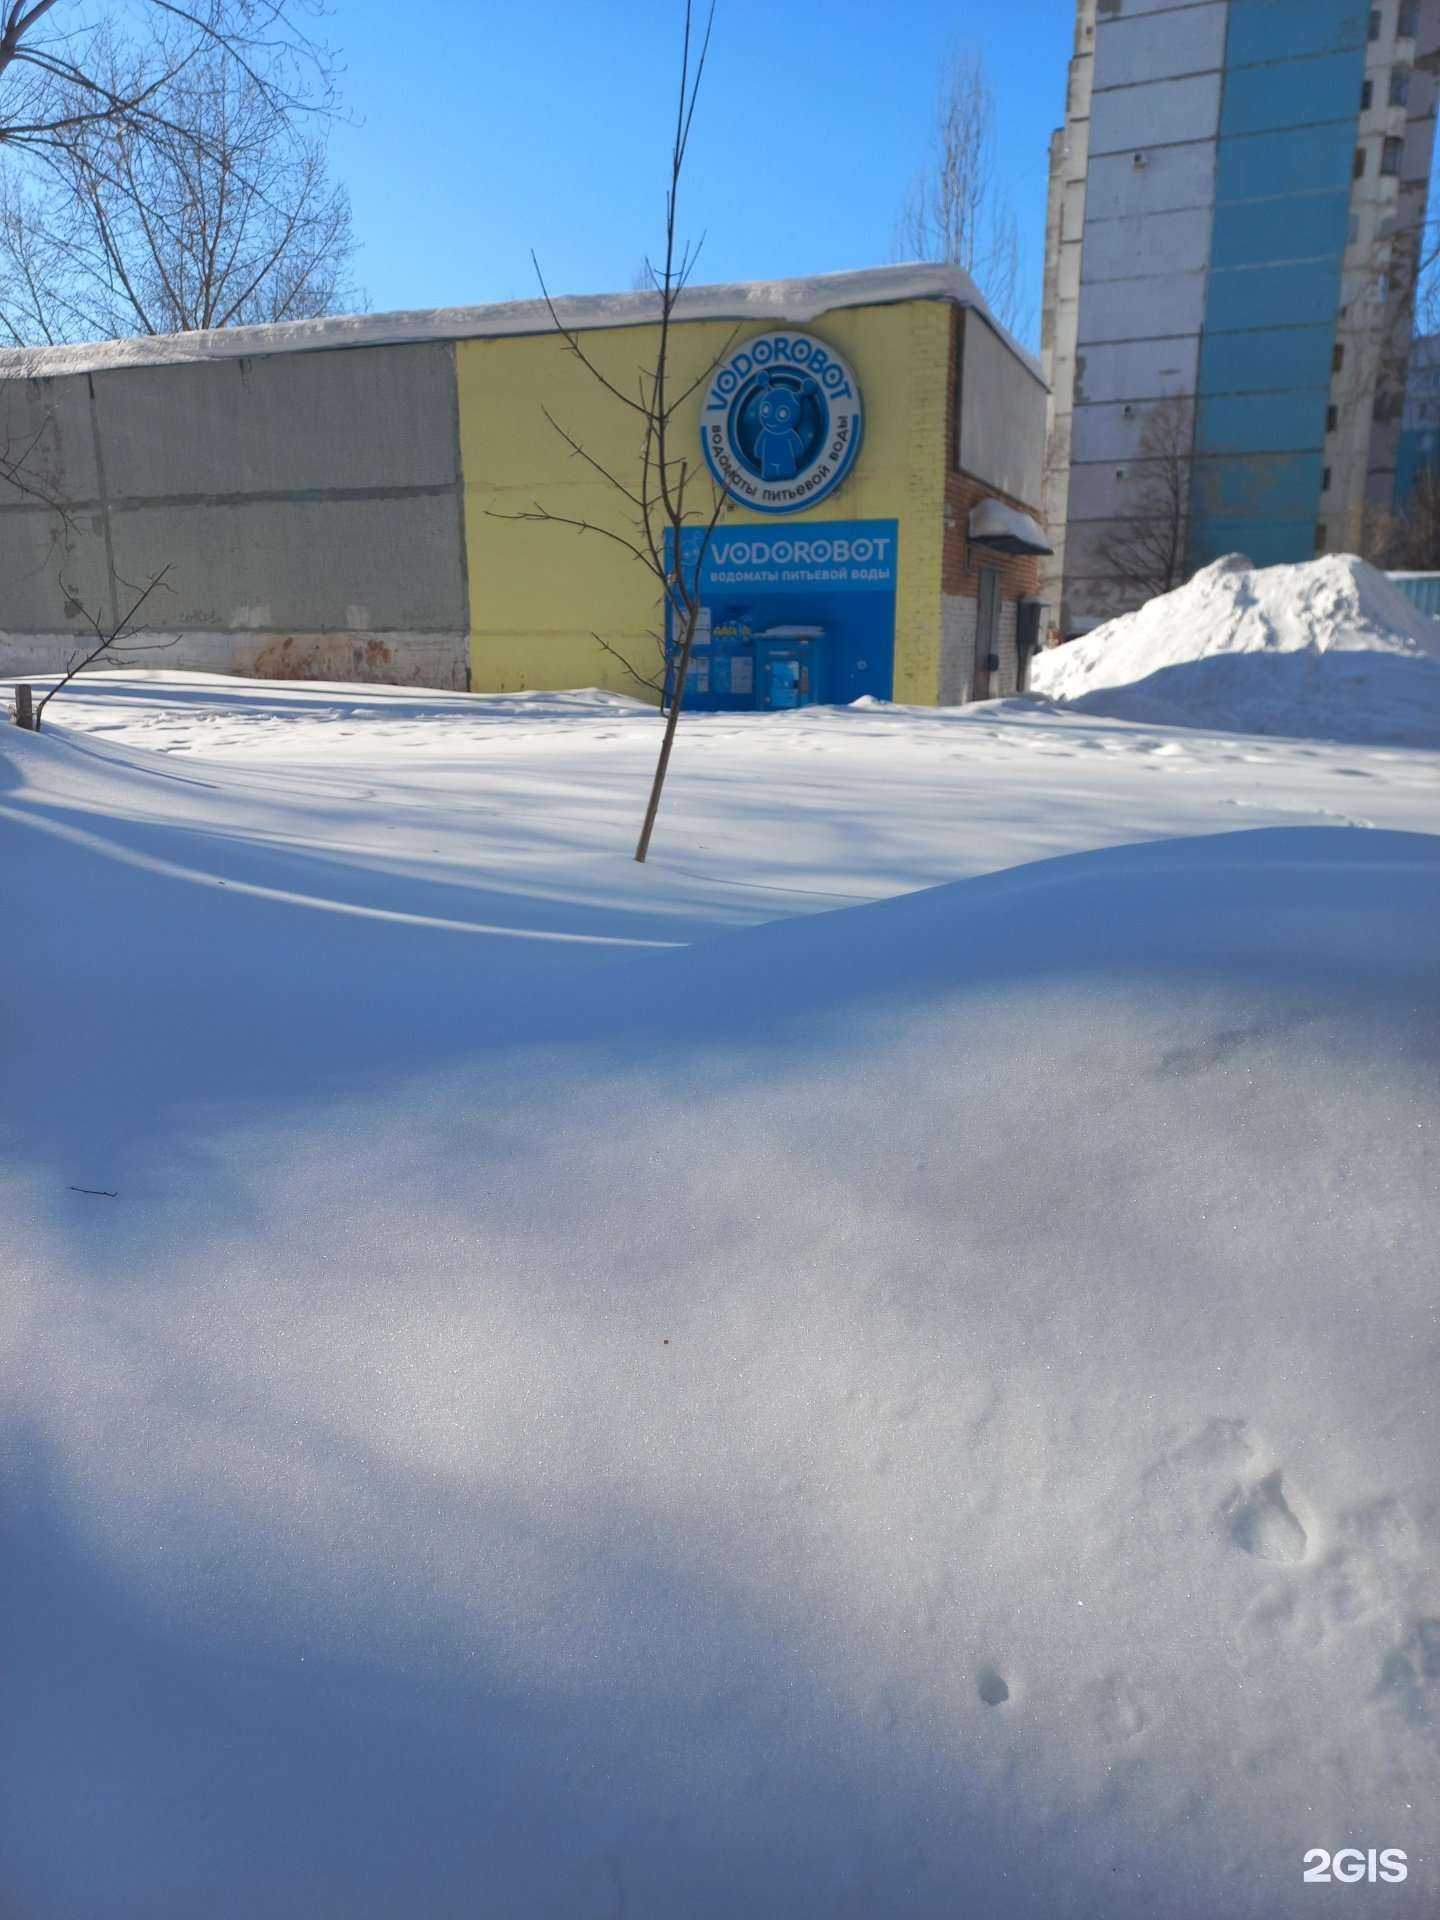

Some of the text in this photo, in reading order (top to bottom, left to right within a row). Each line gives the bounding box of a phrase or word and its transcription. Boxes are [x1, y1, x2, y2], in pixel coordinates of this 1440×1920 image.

[707, 337, 853, 411] VODOROBOT
[829, 415, 849, 462] ВОДЫ
[710, 538, 890, 565] VODOROBOT
[710, 568, 890, 583] ВОДОМАТЫ ПИТЬЕВОЙ ВОДЫ
